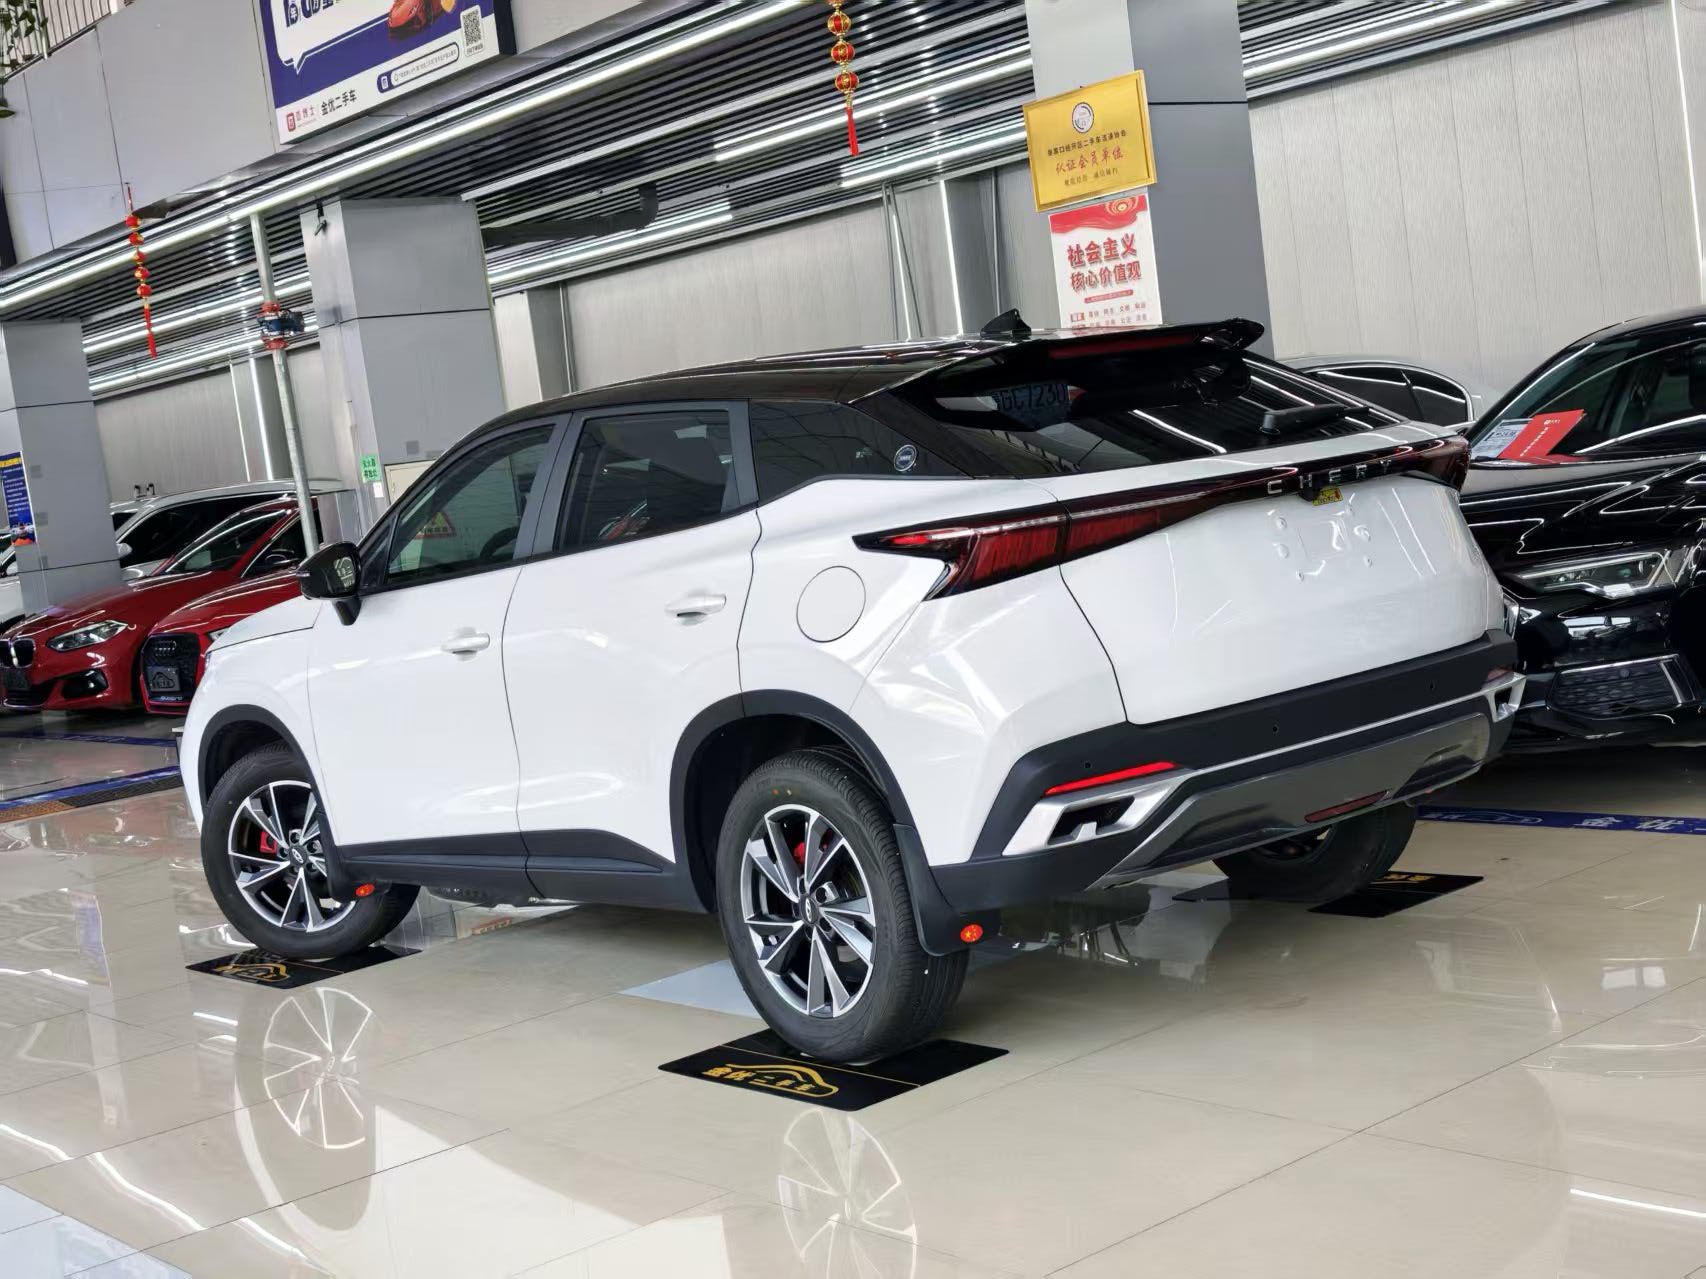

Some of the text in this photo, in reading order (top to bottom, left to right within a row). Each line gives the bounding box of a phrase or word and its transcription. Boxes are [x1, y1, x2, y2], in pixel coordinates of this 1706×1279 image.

[321, 89, 357, 116] 金优二手车
[1055, 145, 1124, 174] 认证会员单位
[1067, 233, 1138, 269] 社会主义
[1070, 261, 1142, 293] 核心价值观
[1267, 458, 1393, 495] CHERY
